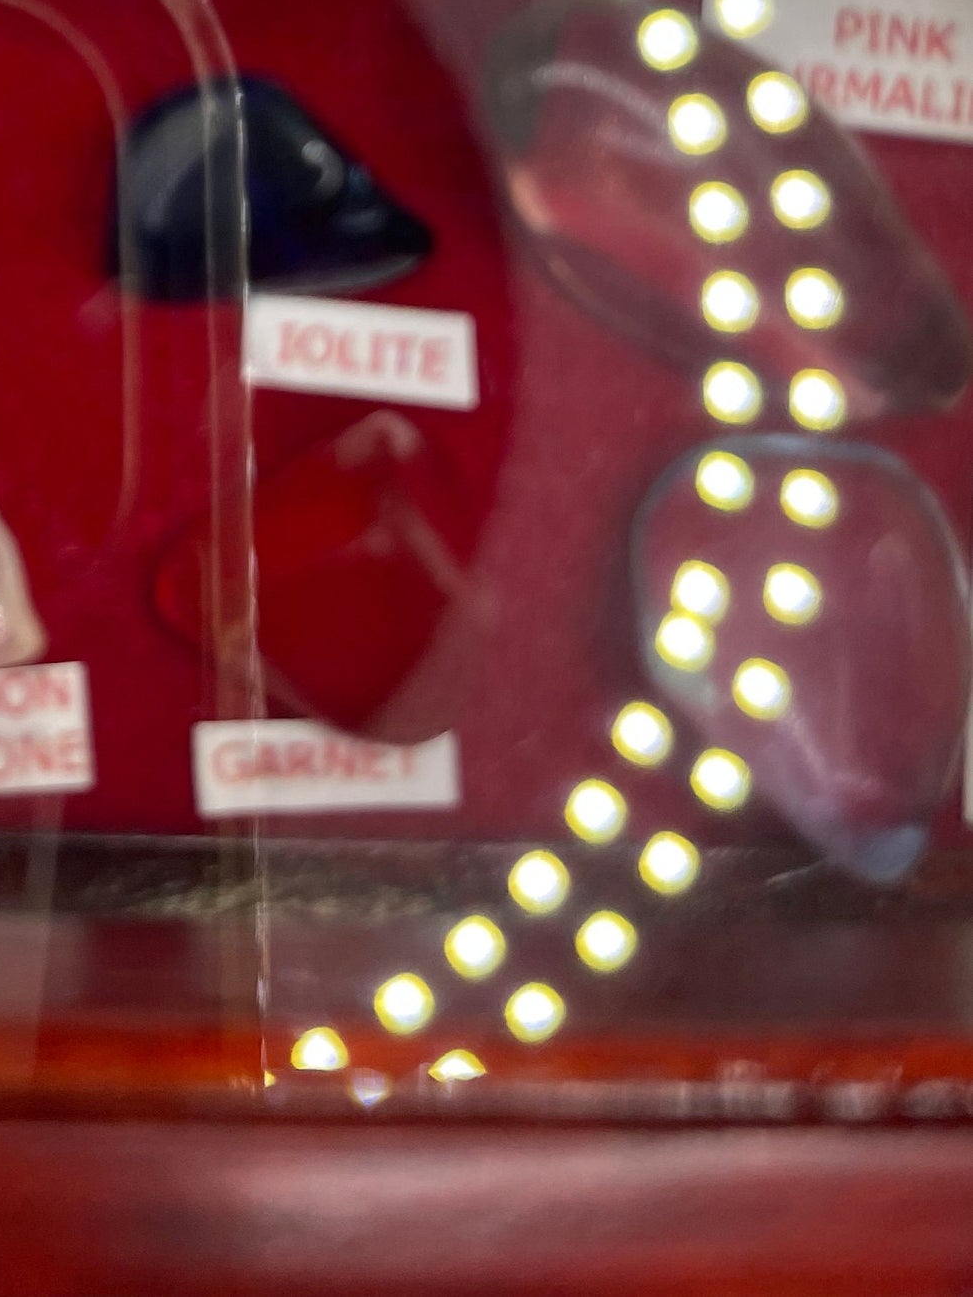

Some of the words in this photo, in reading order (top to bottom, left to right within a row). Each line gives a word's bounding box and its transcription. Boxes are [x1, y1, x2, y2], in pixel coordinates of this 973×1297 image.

[833, 6, 955, 62] PINK
[279, 320, 451, 384] IOLITE
[211, 740, 417, 784] GARNET
